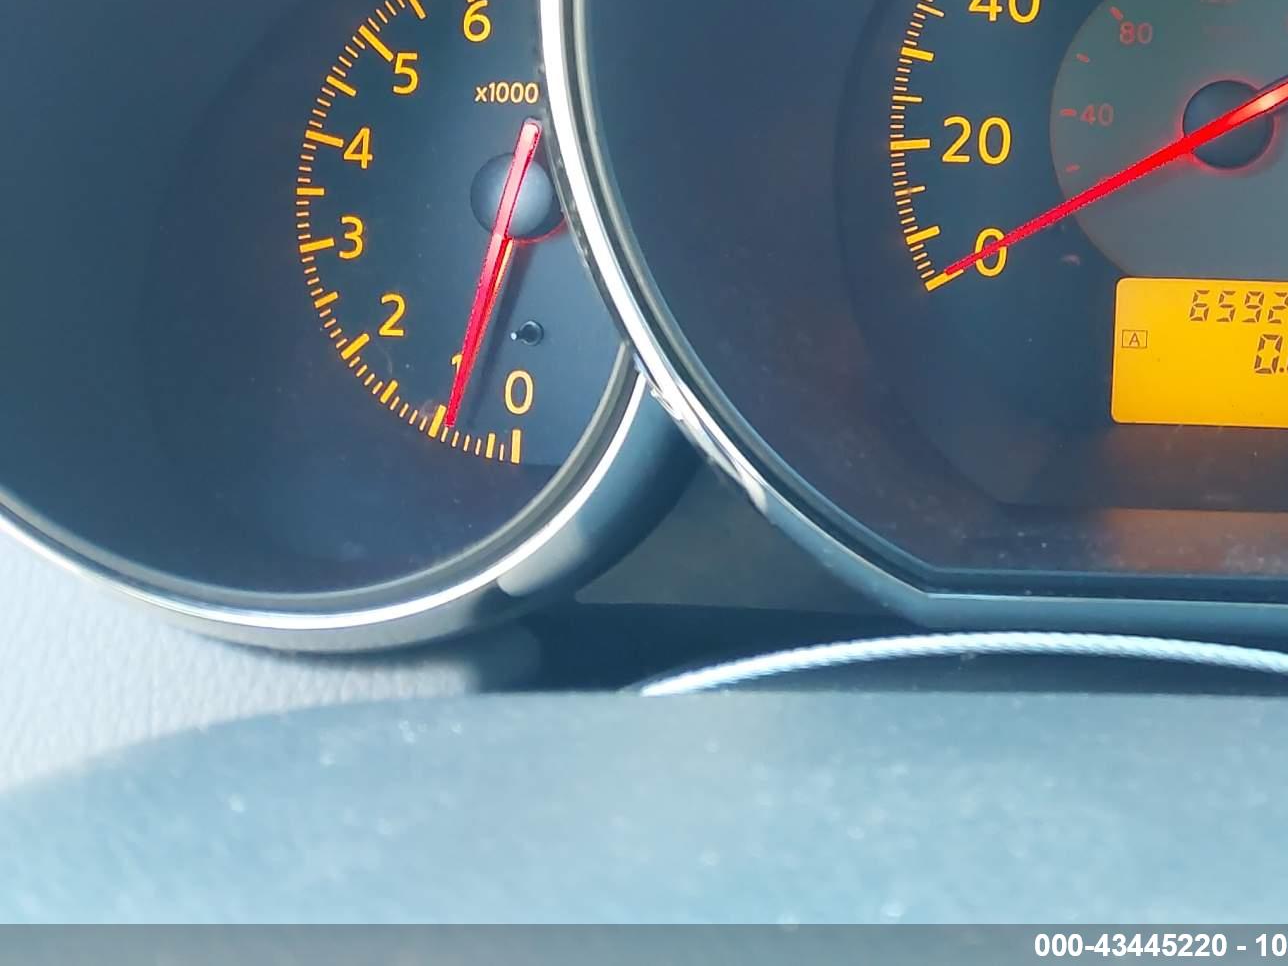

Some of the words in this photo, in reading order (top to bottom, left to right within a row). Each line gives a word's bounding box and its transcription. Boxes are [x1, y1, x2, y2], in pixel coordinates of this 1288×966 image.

[463, 0, 491, 42] 6
[1119, 22, 1153, 45] 80
[392, 53, 418, 94] 5
[475, 83, 538, 103] x1000
[1078, 103, 1114, 126] 40
[343, 128, 373, 169] 4
[942, 116, 1011, 165] 20
[339, 216, 363, 259] 3
[974, 228, 1007, 277] 0
[379, 293, 405, 337] 2
[1128, 332, 1141, 346] A
[504, 370, 532, 414] 0
